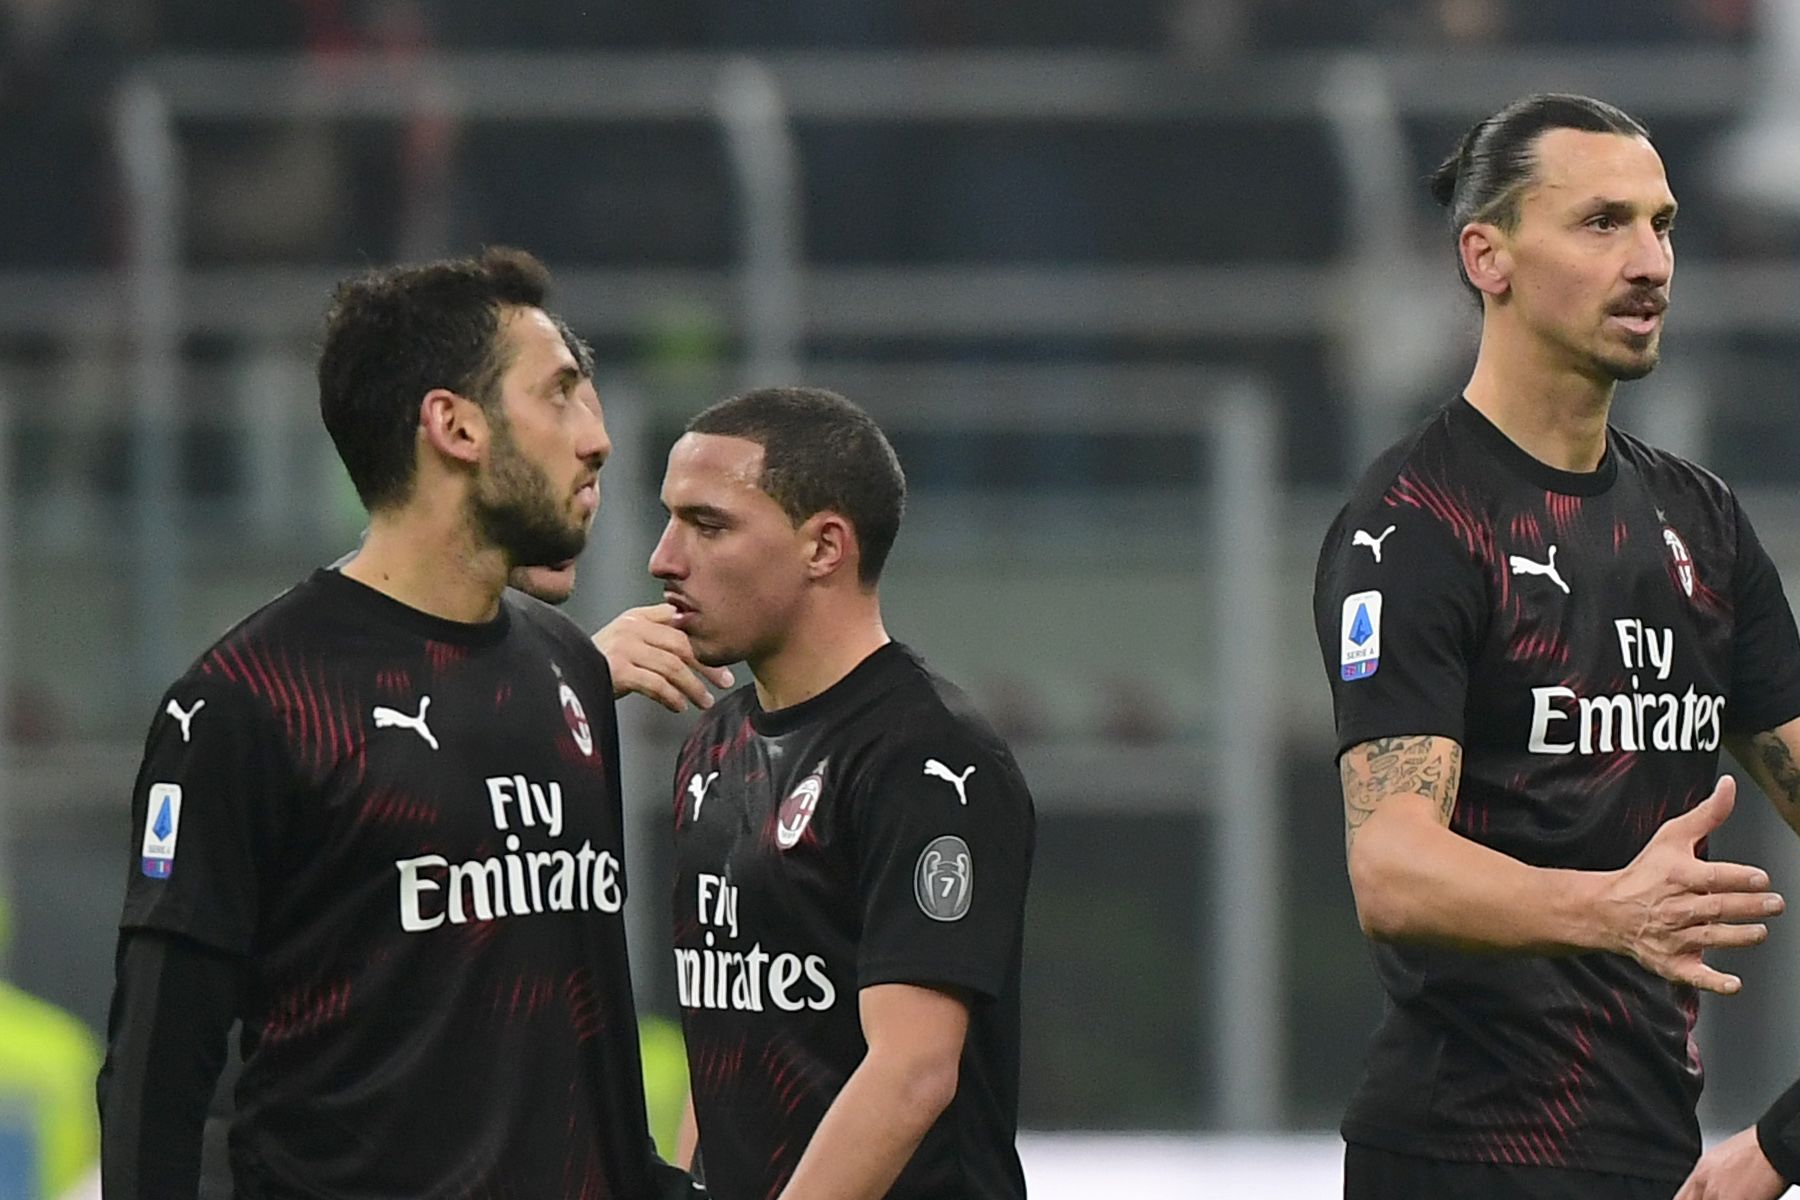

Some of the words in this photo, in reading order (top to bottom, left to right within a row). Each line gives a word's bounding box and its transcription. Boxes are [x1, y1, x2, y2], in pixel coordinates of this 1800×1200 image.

[1614, 618, 1673, 680] Fly
[1528, 674, 1726, 755] Emirates
[485, 774, 563, 837] Fly
[698, 873, 738, 938] Fly
[940, 876, 955, 897] 7
[673, 931, 836, 1012] mirates
